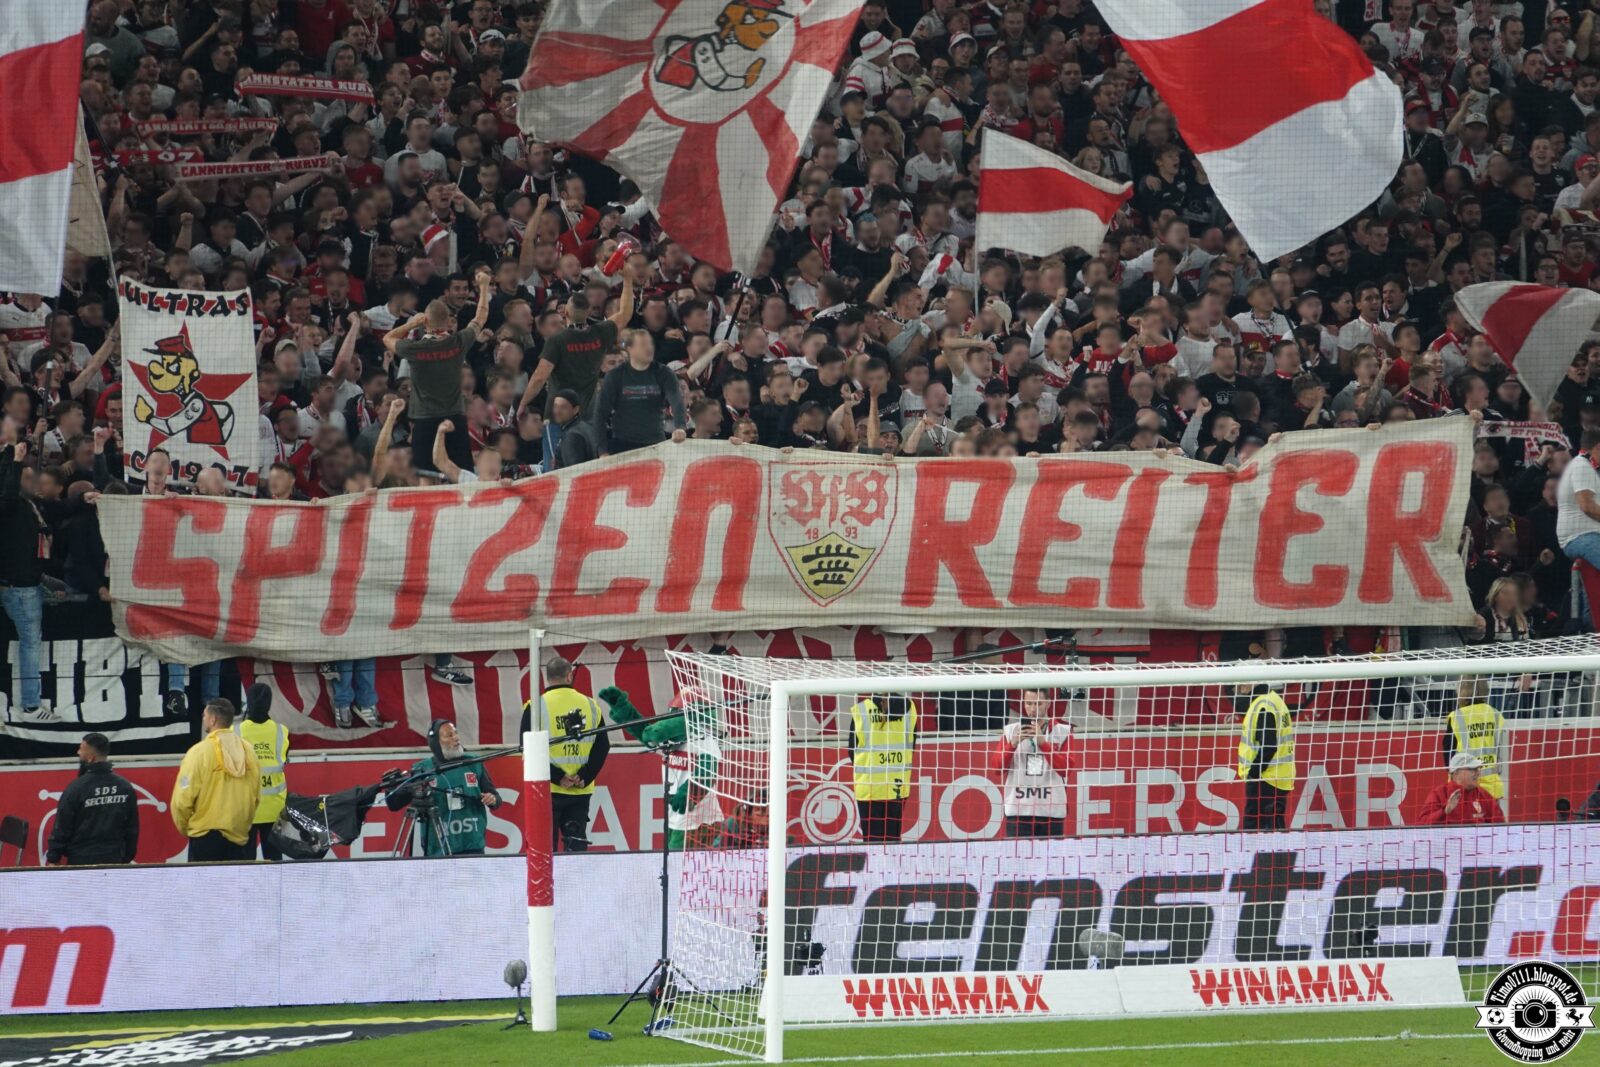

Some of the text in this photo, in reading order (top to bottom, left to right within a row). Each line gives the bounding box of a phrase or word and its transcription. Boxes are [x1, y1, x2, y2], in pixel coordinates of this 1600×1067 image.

[125, 281, 249, 317] ULTRAS
[126, 440, 1459, 644] SPITZEN REITER
[844, 526, 858, 539] 93
[879, 751, 903, 765] 3470
[84, 794, 128, 808] SECURITY
[900, 763, 1409, 841] JOERSAR
[1015, 785, 1052, 800] SMF
[842, 974, 1050, 1018] WINAMAX
[1189, 962, 1396, 1008] WINAMAX
